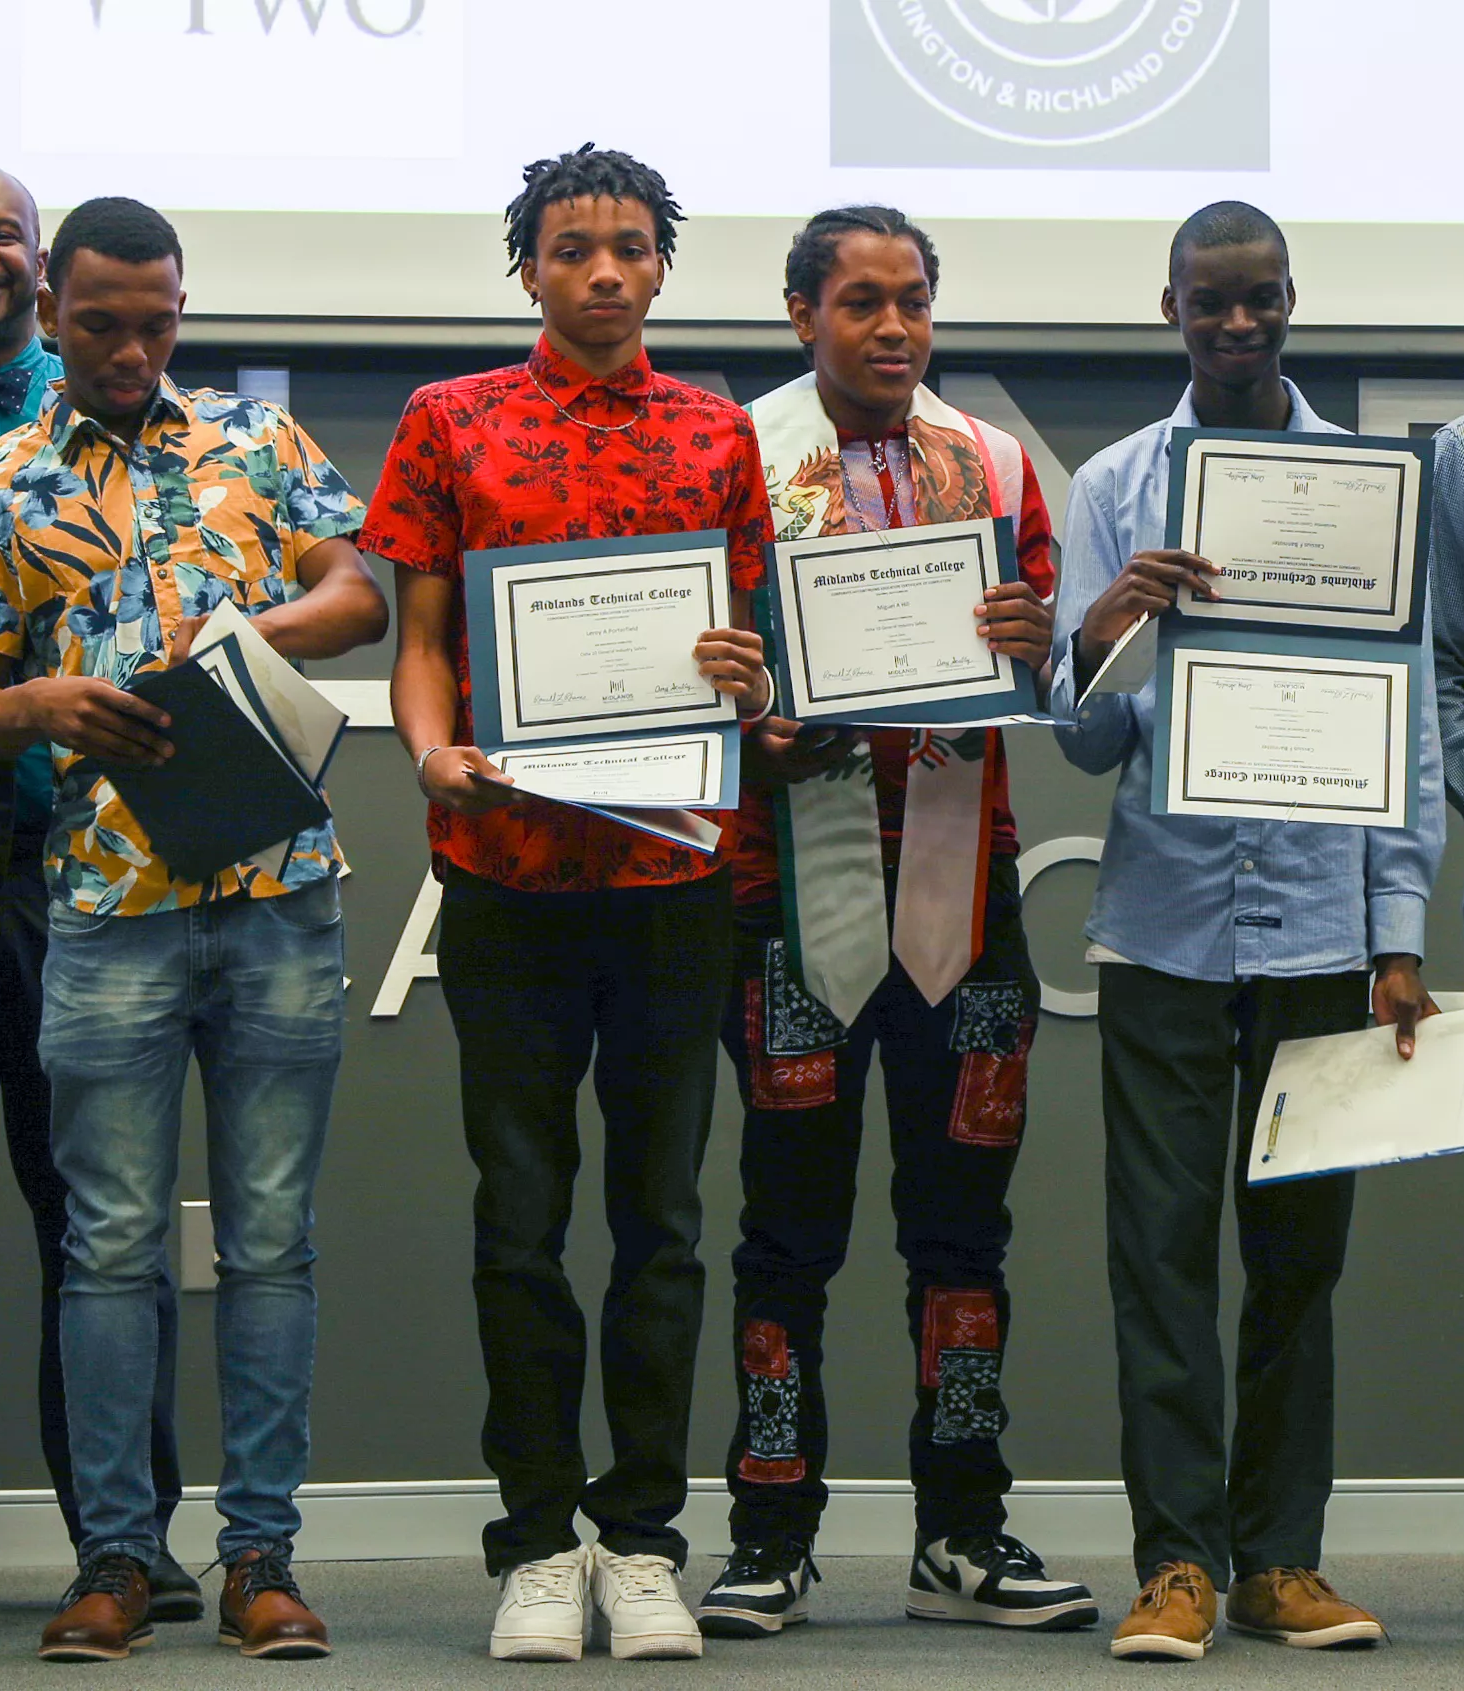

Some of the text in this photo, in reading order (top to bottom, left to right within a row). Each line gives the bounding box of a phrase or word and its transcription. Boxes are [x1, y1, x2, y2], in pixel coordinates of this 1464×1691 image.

[996, 82, 1015, 108] &
[1025, 52, 1163, 113] RICHLAND
[813, 561, 964, 588] Midlands Technical College
[1262, 571, 1315, 585] Technical
[1321, 575, 1376, 589] Midlands
[530, 588, 691, 612] Midlands Technical College
[888, 667, 917, 675] MIDLANDS
[583, 757, 637, 765] Technical
[1204, 768, 1368, 789] Midlands Technical College
